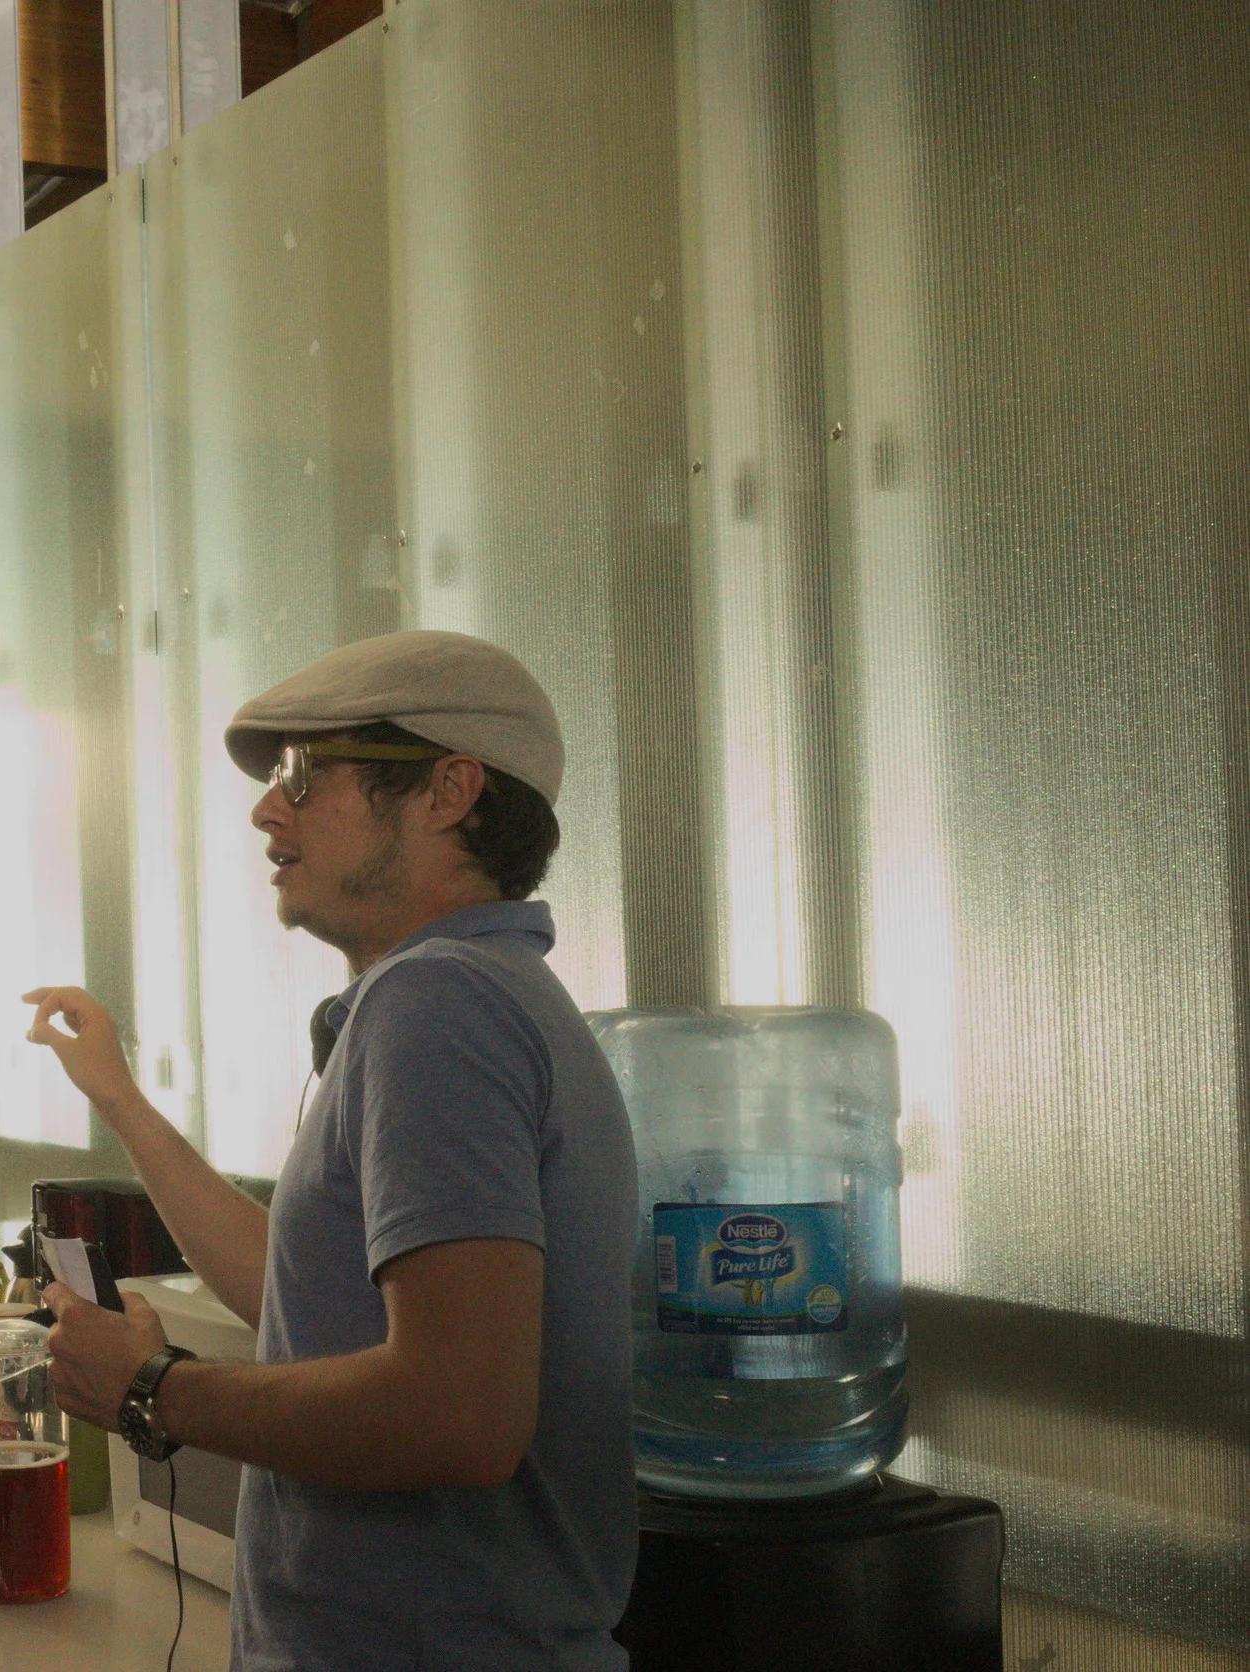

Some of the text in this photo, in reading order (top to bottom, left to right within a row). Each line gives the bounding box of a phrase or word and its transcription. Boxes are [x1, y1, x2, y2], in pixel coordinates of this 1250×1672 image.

[727, 1223, 778, 1238] Nestlé
[717, 1253, 789, 1276] Pure Life
